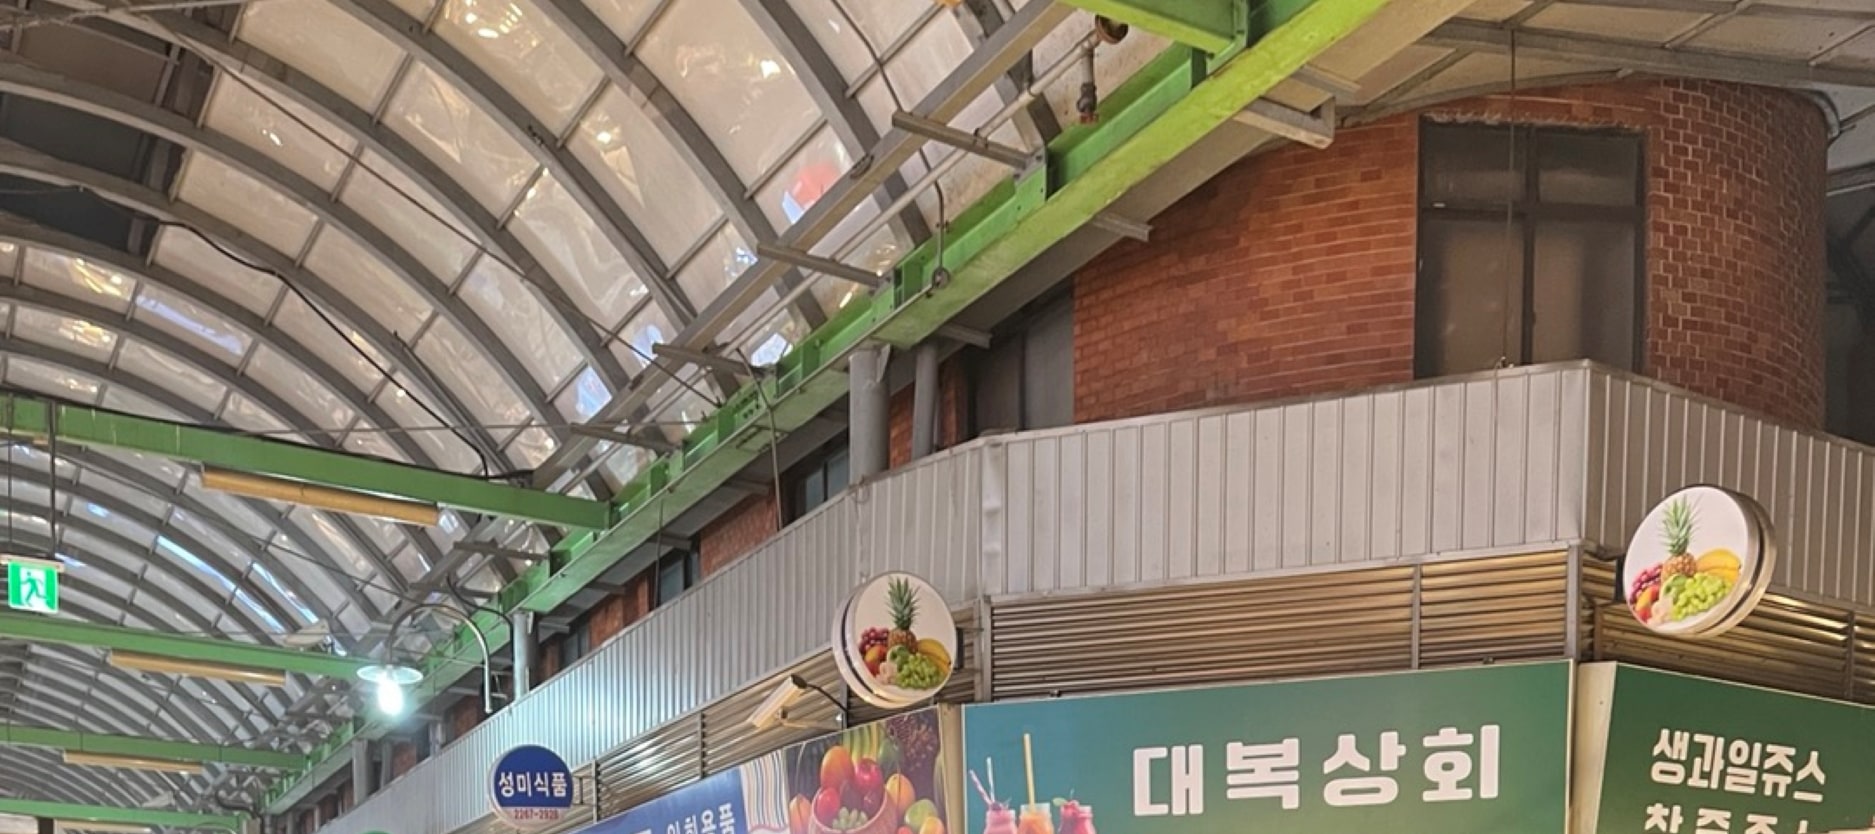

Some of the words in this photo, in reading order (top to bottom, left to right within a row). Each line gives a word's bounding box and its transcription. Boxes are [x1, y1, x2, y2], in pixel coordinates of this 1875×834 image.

[498, 771, 567, 797] 성미식품
[1133, 725, 1500, 816] 대복상회
[1650, 728, 1826, 803] 생과일쥬스
